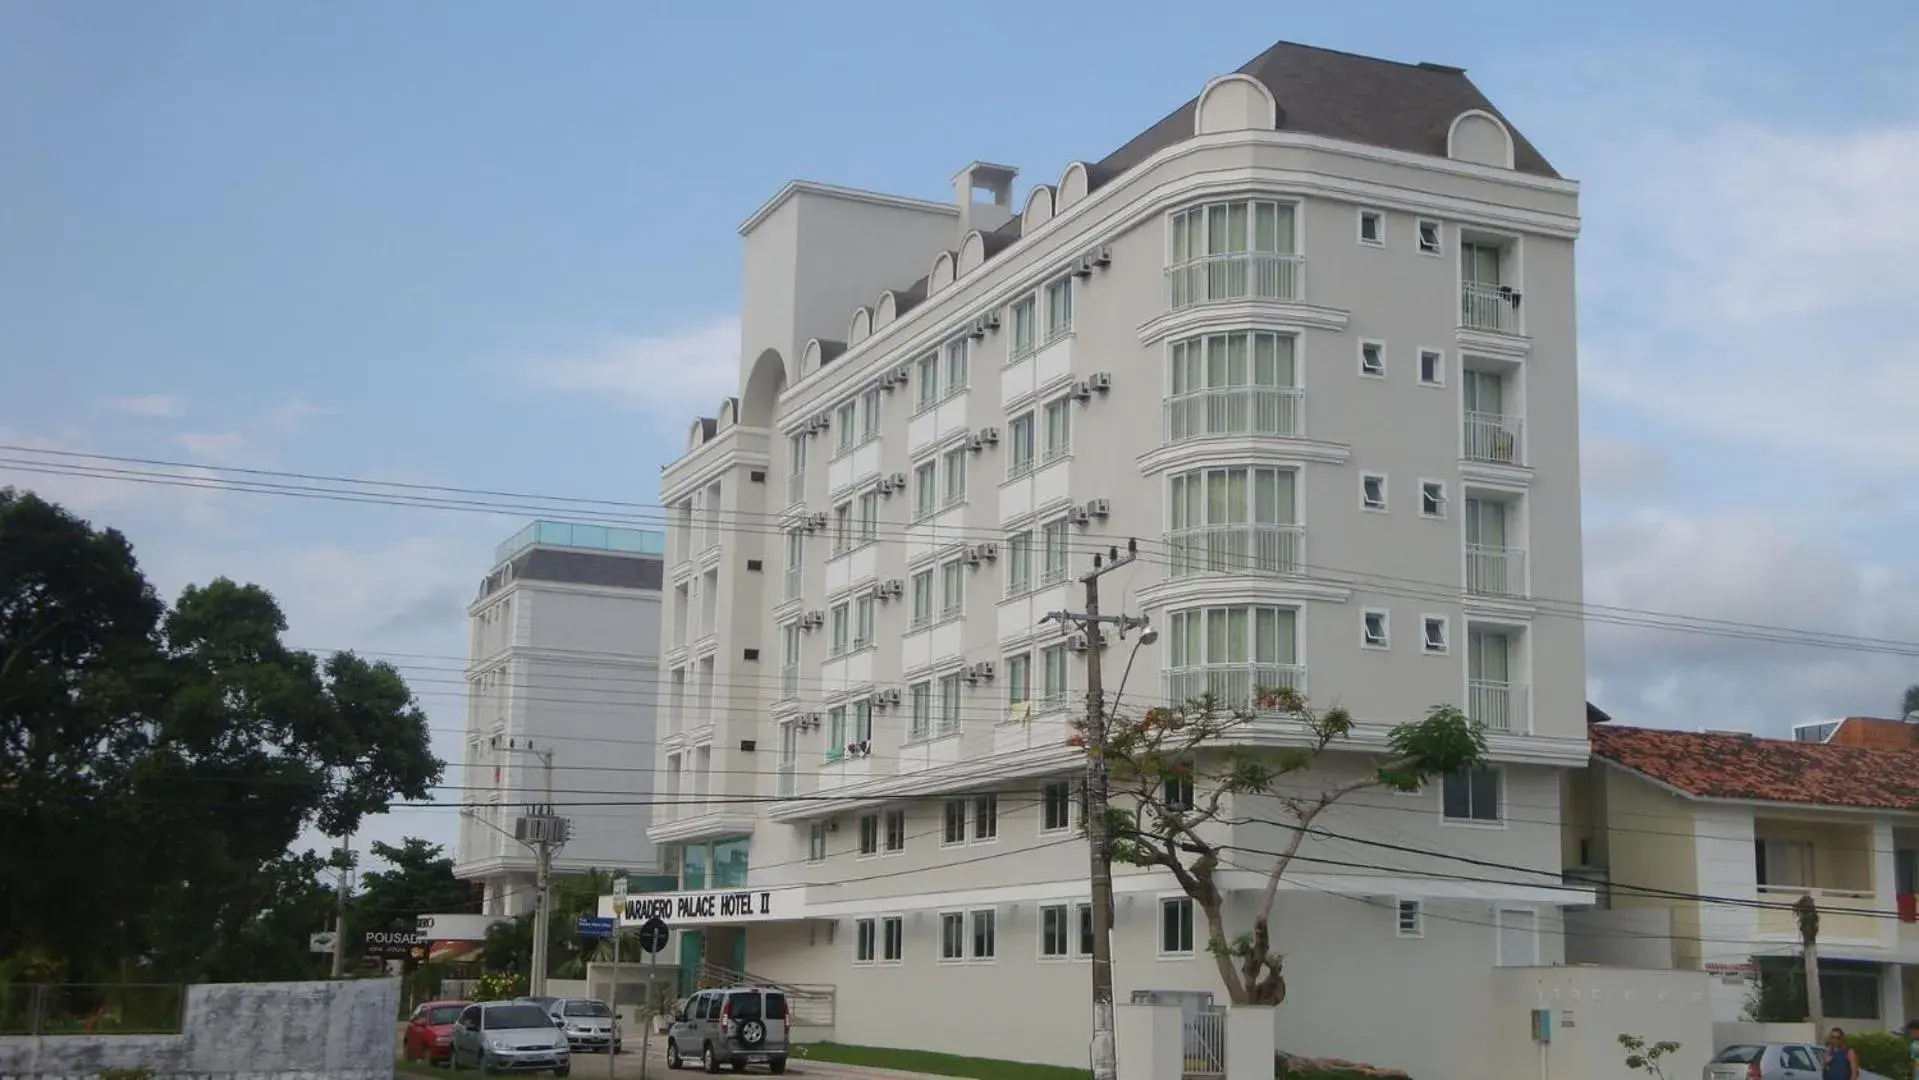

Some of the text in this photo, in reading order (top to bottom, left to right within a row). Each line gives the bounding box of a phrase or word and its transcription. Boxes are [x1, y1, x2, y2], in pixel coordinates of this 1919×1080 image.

[625, 892, 771, 920] VARADERO PALACE HOTEL II
